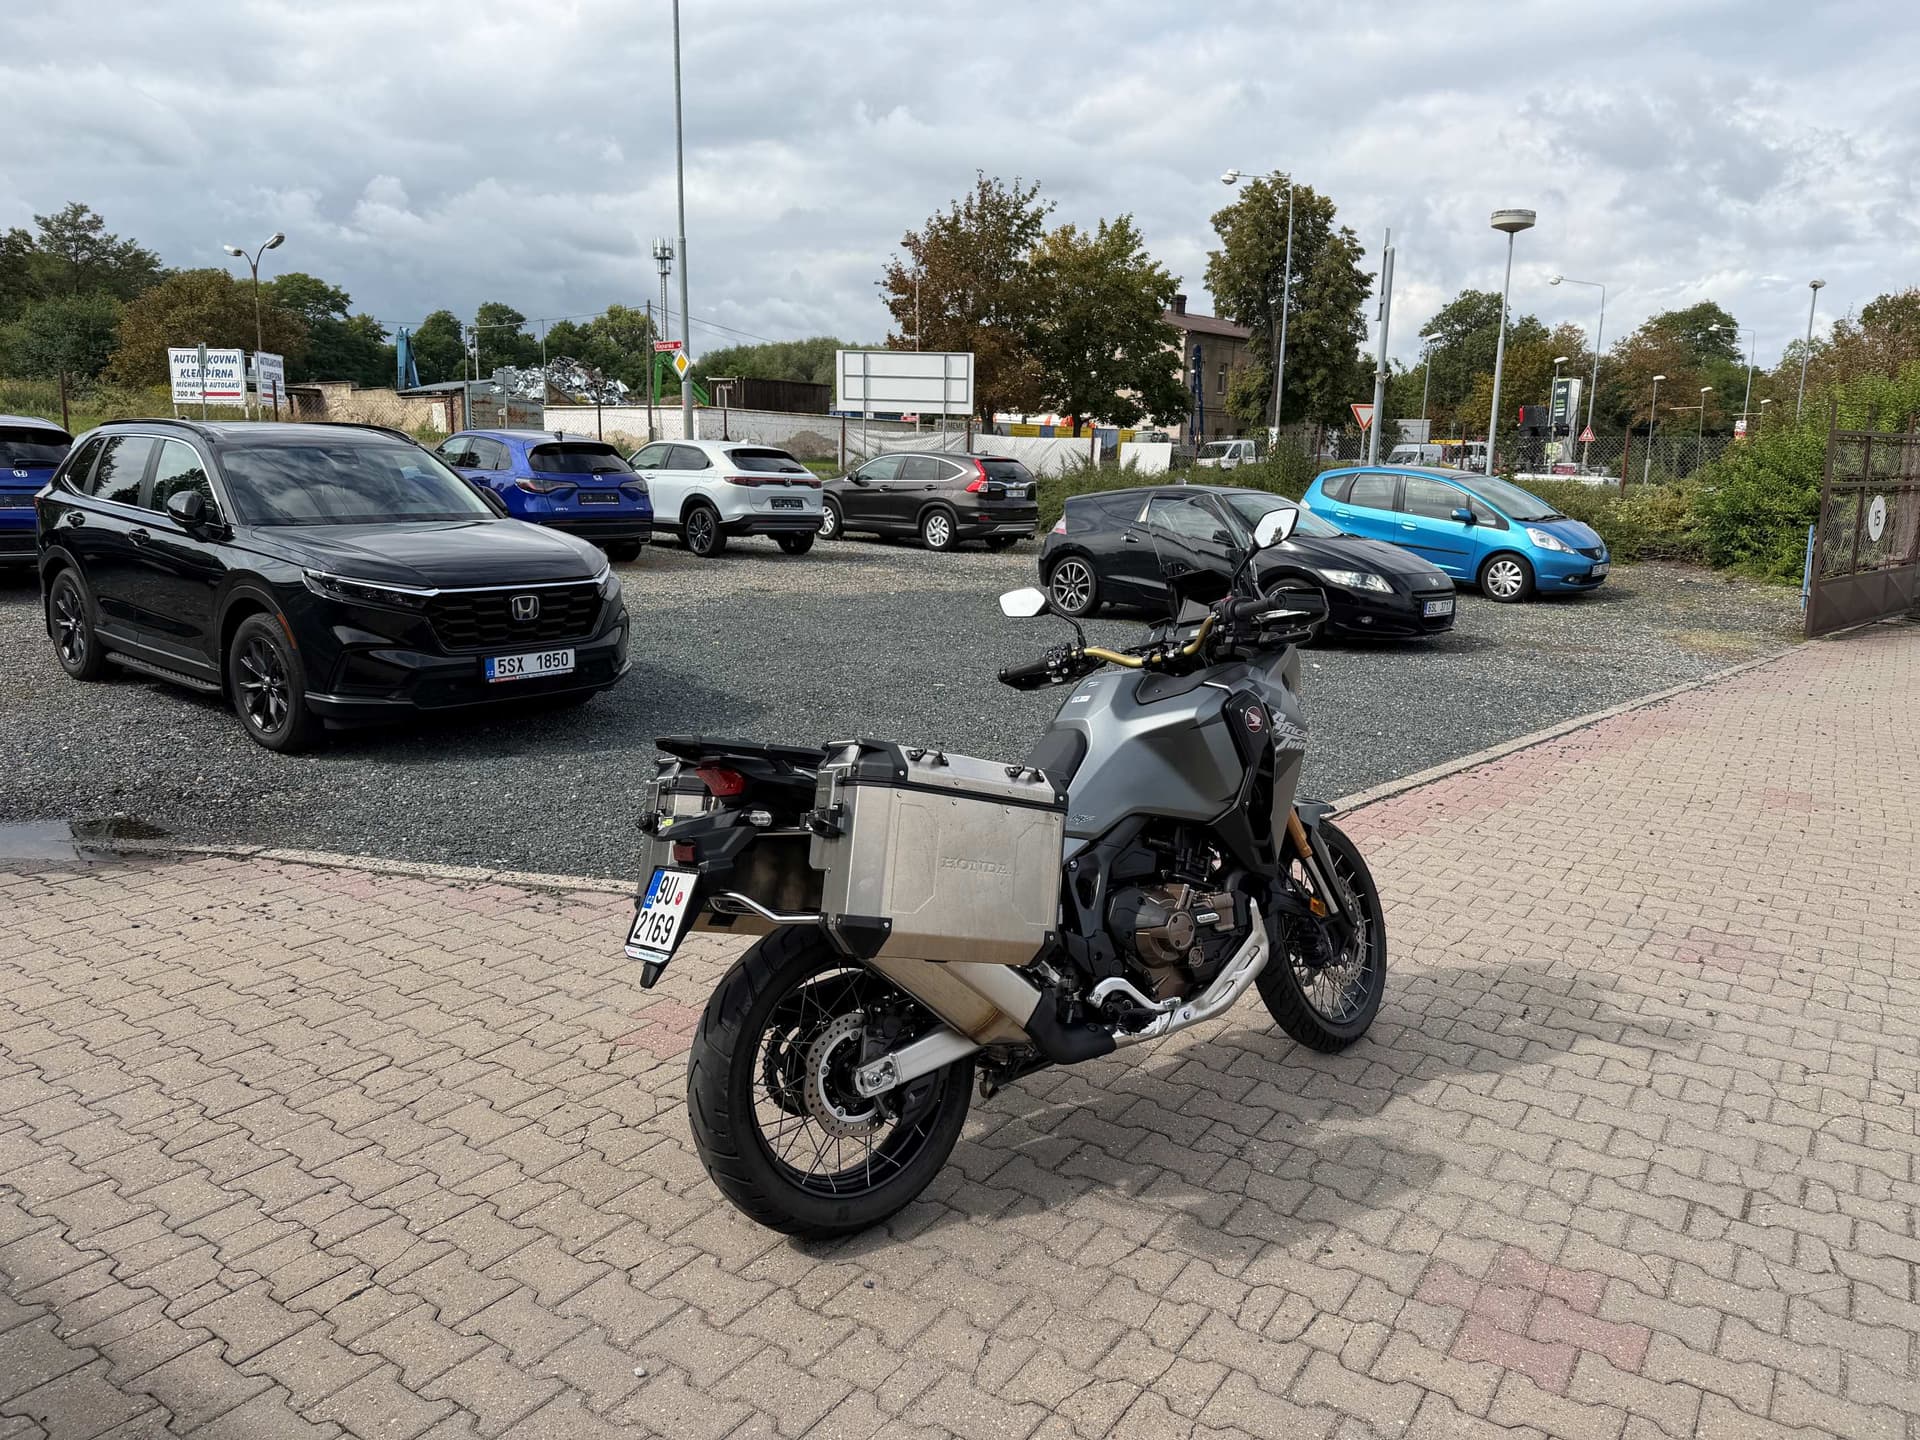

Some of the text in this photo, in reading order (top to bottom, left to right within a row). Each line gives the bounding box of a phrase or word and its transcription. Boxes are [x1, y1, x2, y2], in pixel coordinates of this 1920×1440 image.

[173, 354, 238, 364] AUTOKOVNA
[1873, 510, 1881, 528] 15
[498, 657, 524, 674] 5SX
[536, 652, 569, 670] 1850
[656, 875, 680, 906] 9U
[633, 910, 675, 945] 2169
